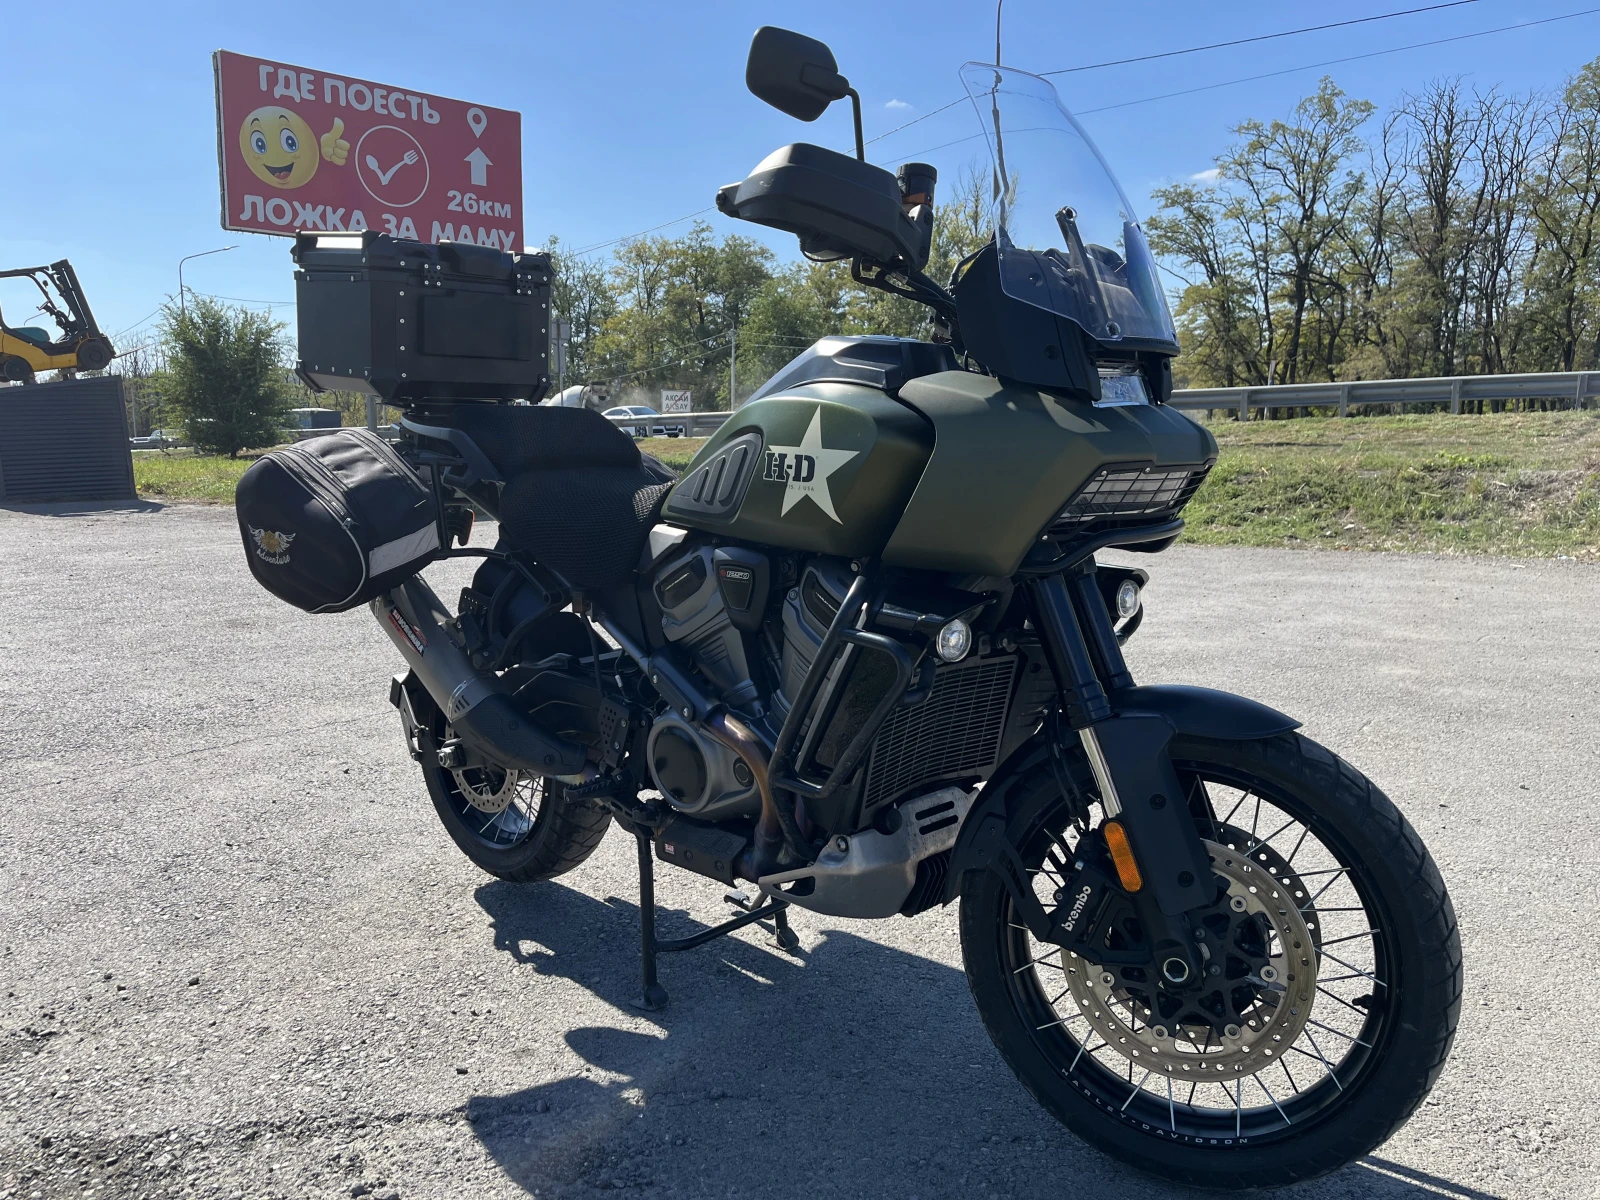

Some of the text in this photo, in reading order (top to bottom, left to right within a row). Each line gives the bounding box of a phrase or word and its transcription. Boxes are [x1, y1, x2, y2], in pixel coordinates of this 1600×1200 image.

[258, 64, 441, 125] ГДЕ ПОЕСТЬ
[239, 194, 516, 253] ЛОЖКА ЗА МАМУ
[446, 189, 512, 219] 26км
[763, 450, 816, 482] H-D
[1061, 885, 1092, 932] brembo
